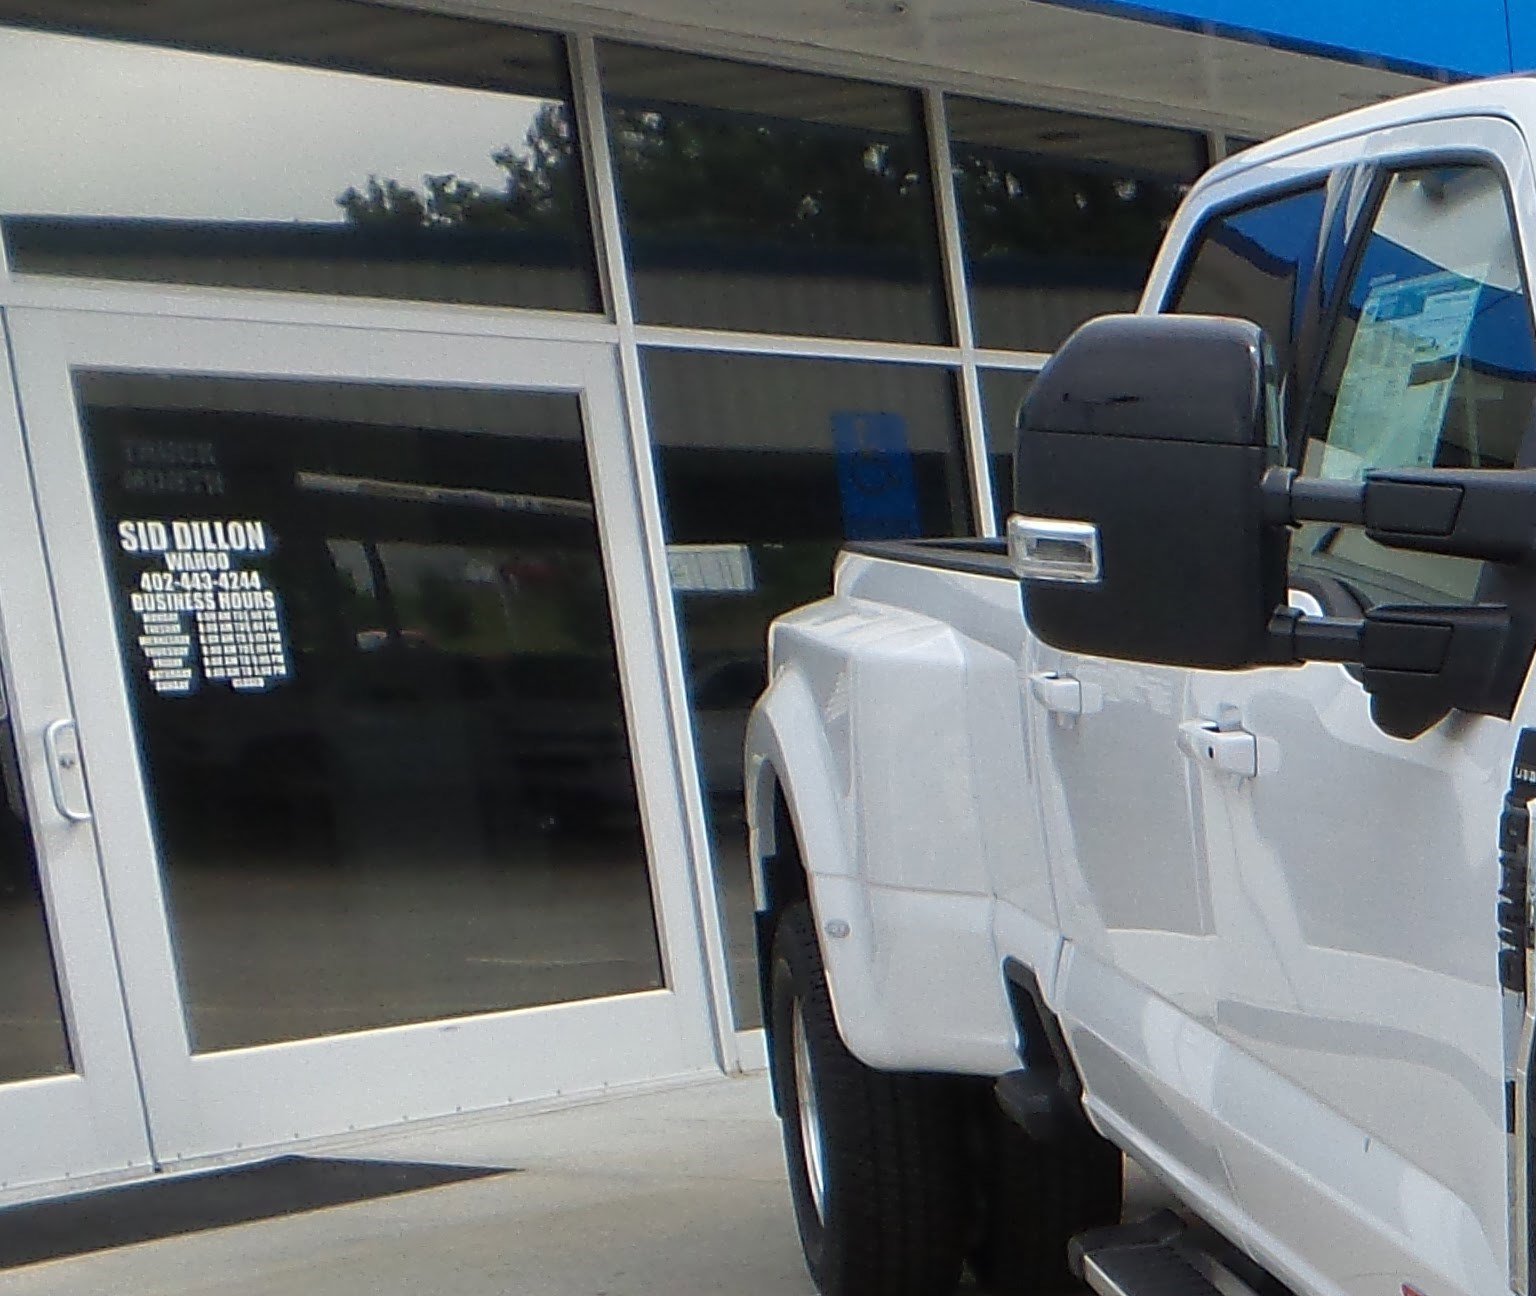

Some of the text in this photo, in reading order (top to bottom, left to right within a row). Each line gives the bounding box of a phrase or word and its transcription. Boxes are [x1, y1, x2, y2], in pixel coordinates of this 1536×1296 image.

[118, 520, 266, 551] SID DILLON
[164, 551, 230, 571] WAHOO
[140, 571, 261, 592] 402-443-4244
[130, 590, 276, 612] BUSINESS HOURS
